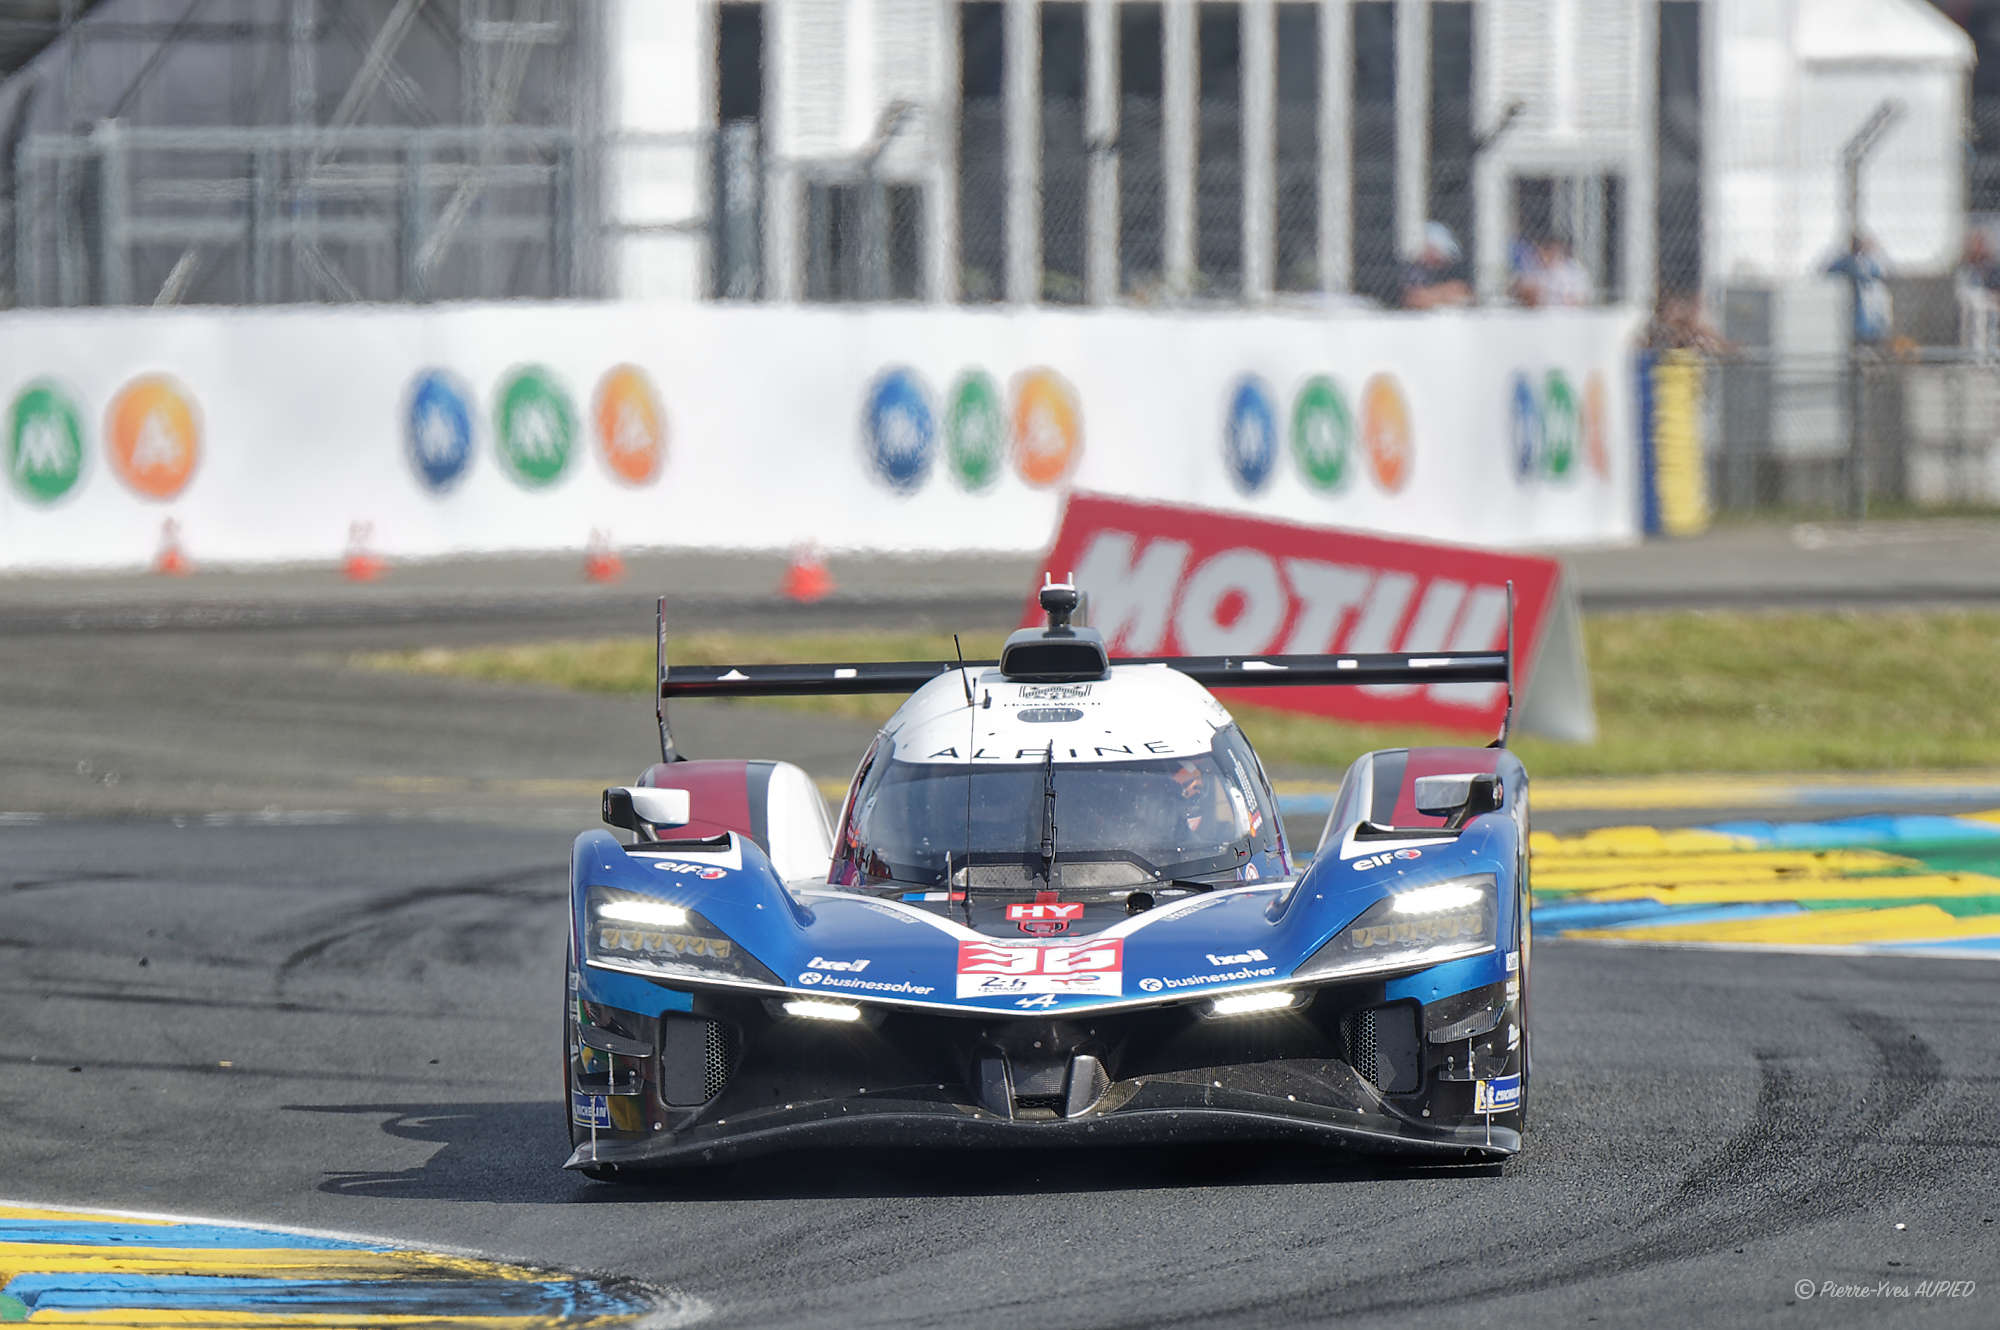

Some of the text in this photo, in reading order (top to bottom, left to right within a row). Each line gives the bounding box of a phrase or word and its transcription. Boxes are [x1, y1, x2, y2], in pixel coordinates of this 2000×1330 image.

[1075, 529, 1510, 709] MOTUL
[928, 740, 1175, 759] ALPINE
[653, 861, 704, 874] elf
[1352, 852, 1395, 871] elf
[1011, 904, 1079, 918] HY
[960, 939, 1120, 975] 36
[821, 974, 936, 995] businessolver
[1162, 966, 1277, 989] businessolver
